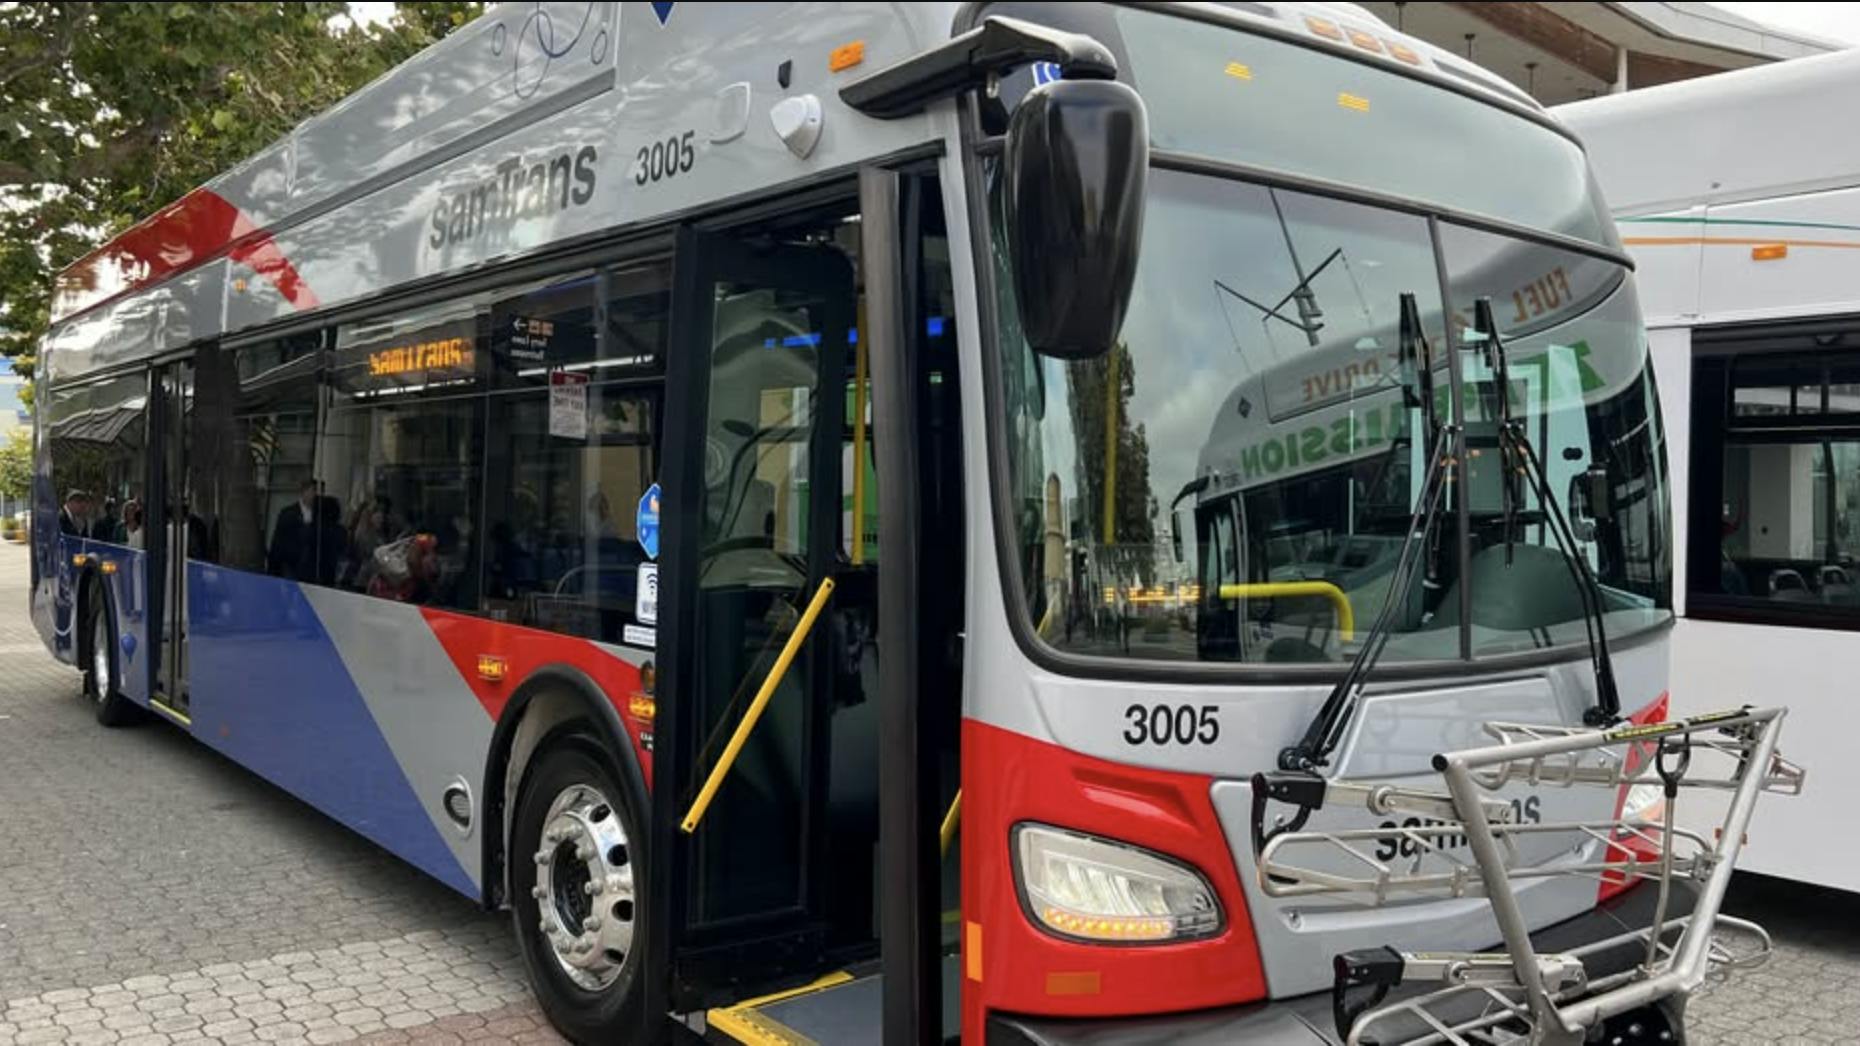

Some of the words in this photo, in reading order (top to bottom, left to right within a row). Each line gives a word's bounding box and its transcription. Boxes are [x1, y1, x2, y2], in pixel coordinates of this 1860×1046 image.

[635, 130, 696, 186] 3005
[430, 145, 597, 250] samTrans
[1123, 703, 1220, 746] 3005
